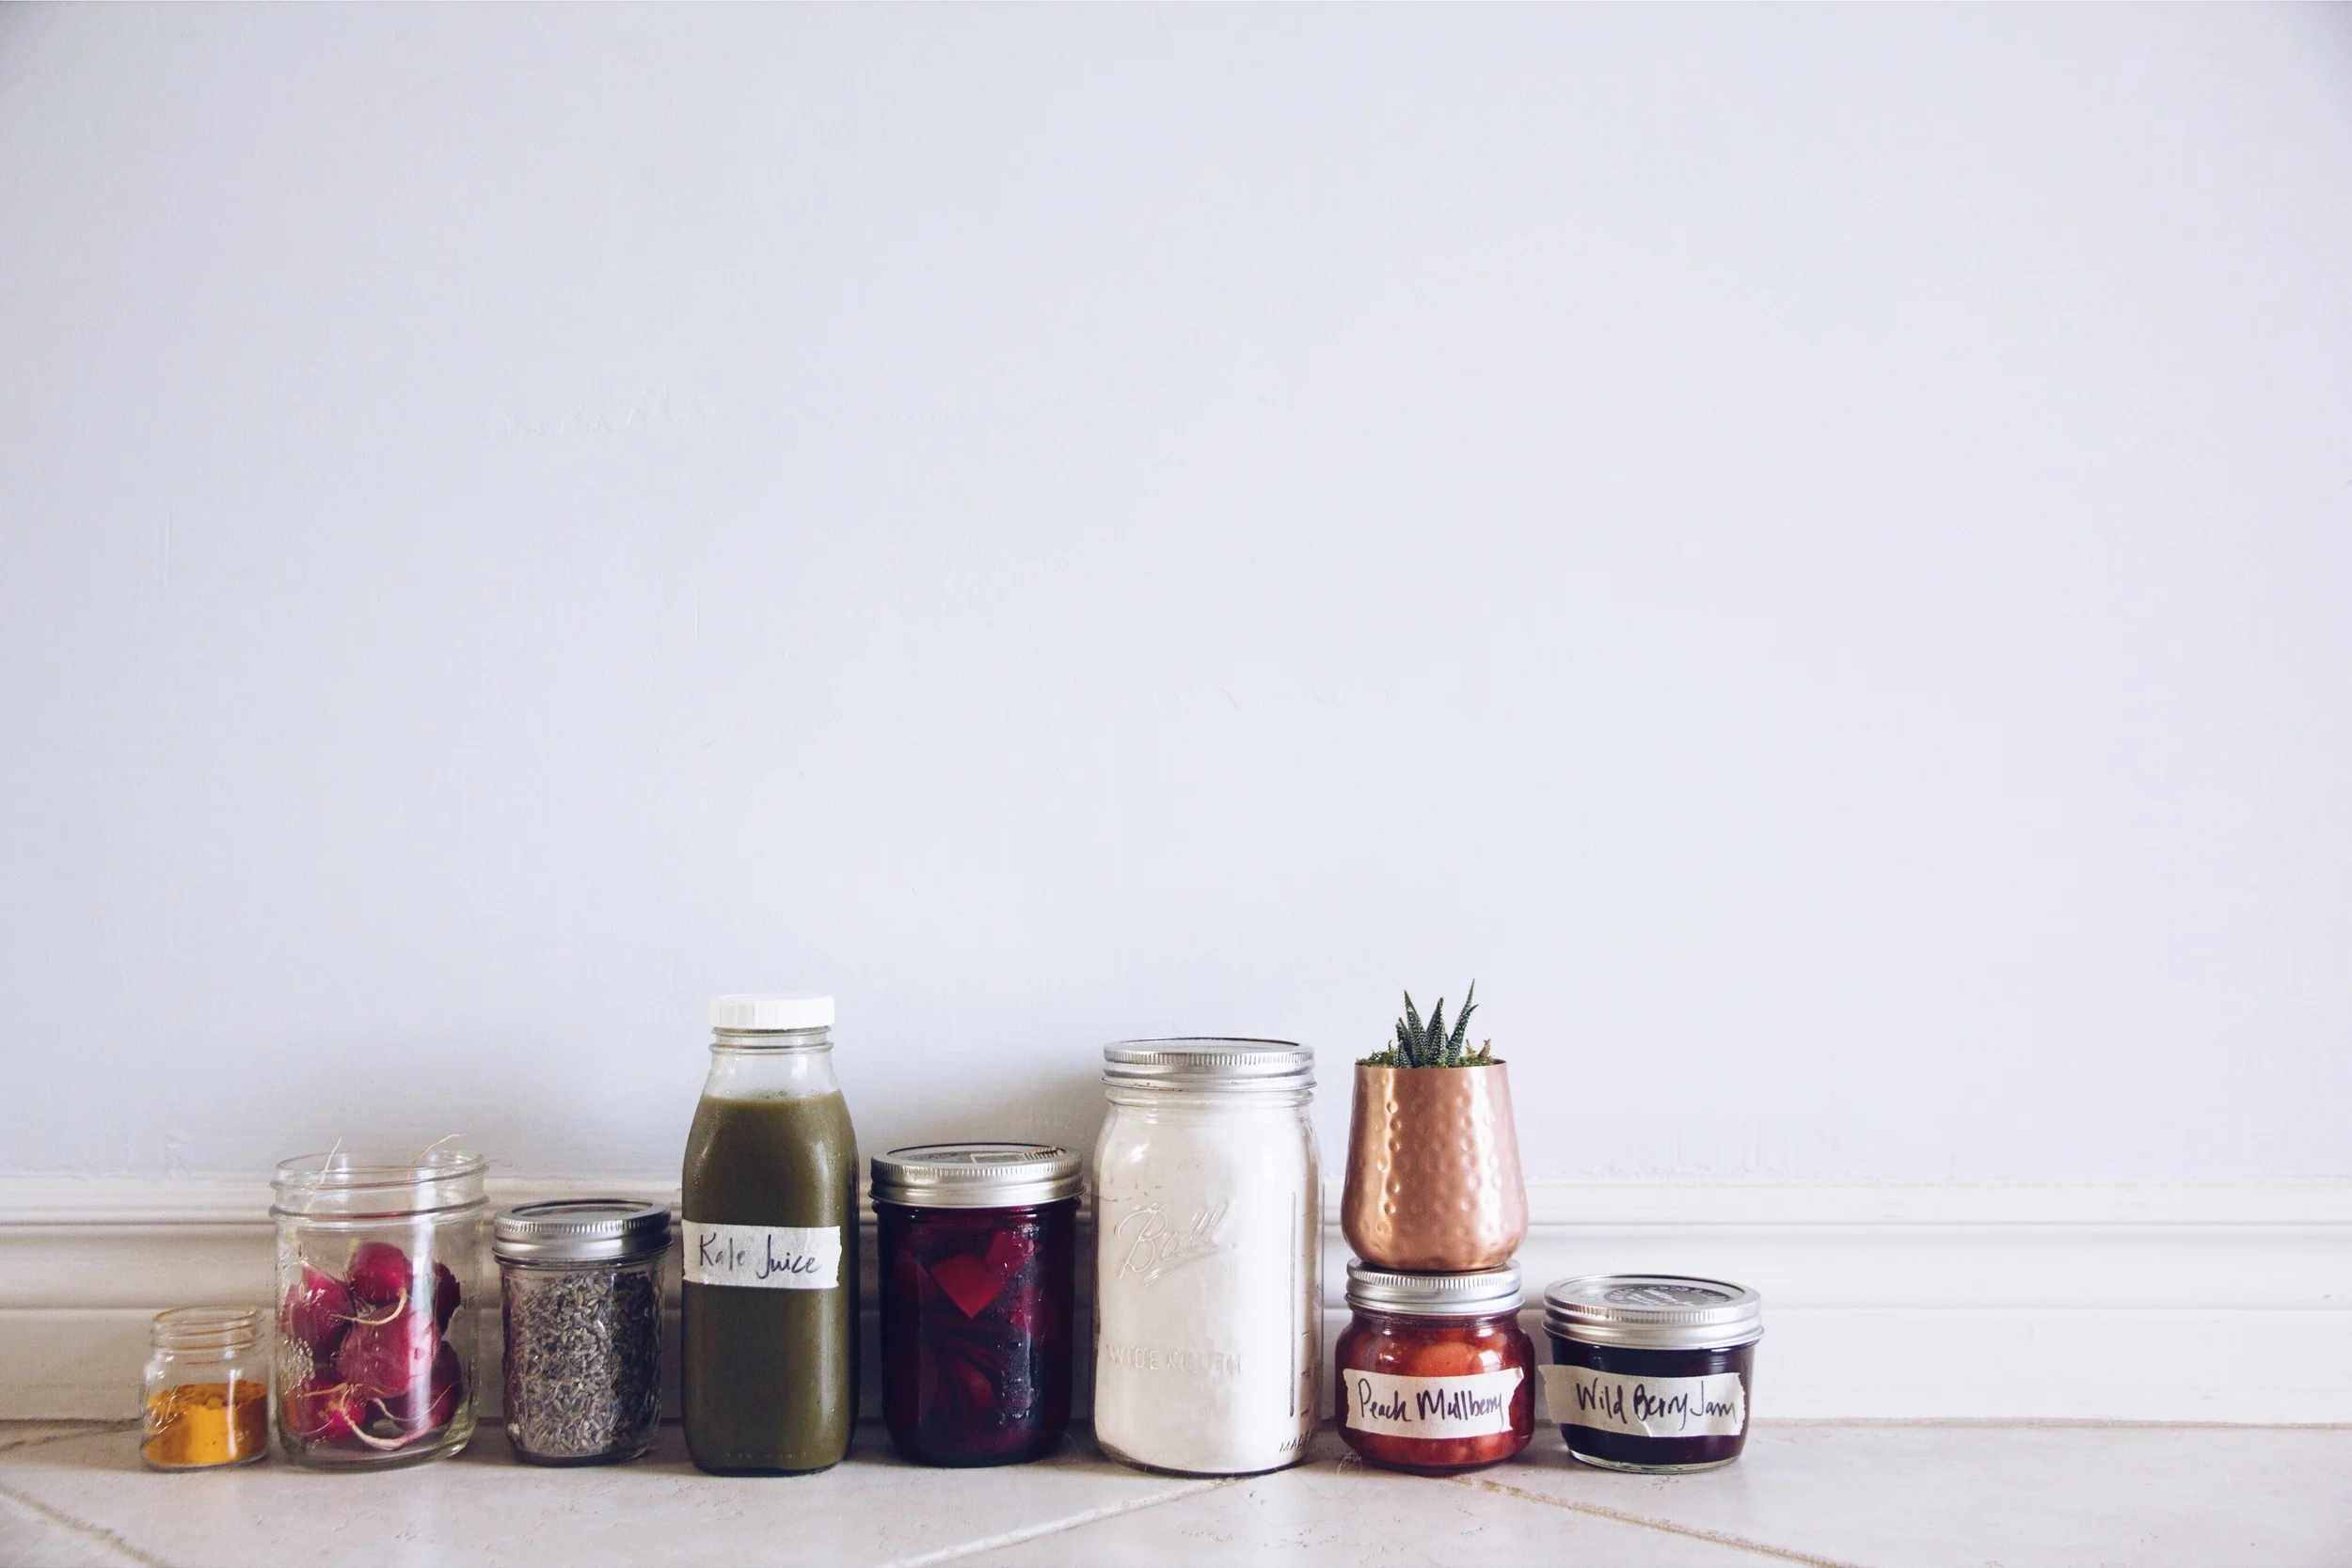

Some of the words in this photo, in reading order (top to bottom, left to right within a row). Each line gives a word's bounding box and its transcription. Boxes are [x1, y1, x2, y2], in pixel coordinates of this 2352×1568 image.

[699, 1232, 746, 1271] Kale
[755, 1233, 821, 1279] Juice
[1358, 1377, 1411, 1422] Peach
[1576, 1377, 1628, 1425] Wild
[1632, 1383, 1689, 1432] Berry
[1690, 1379, 1739, 1424] Jam
